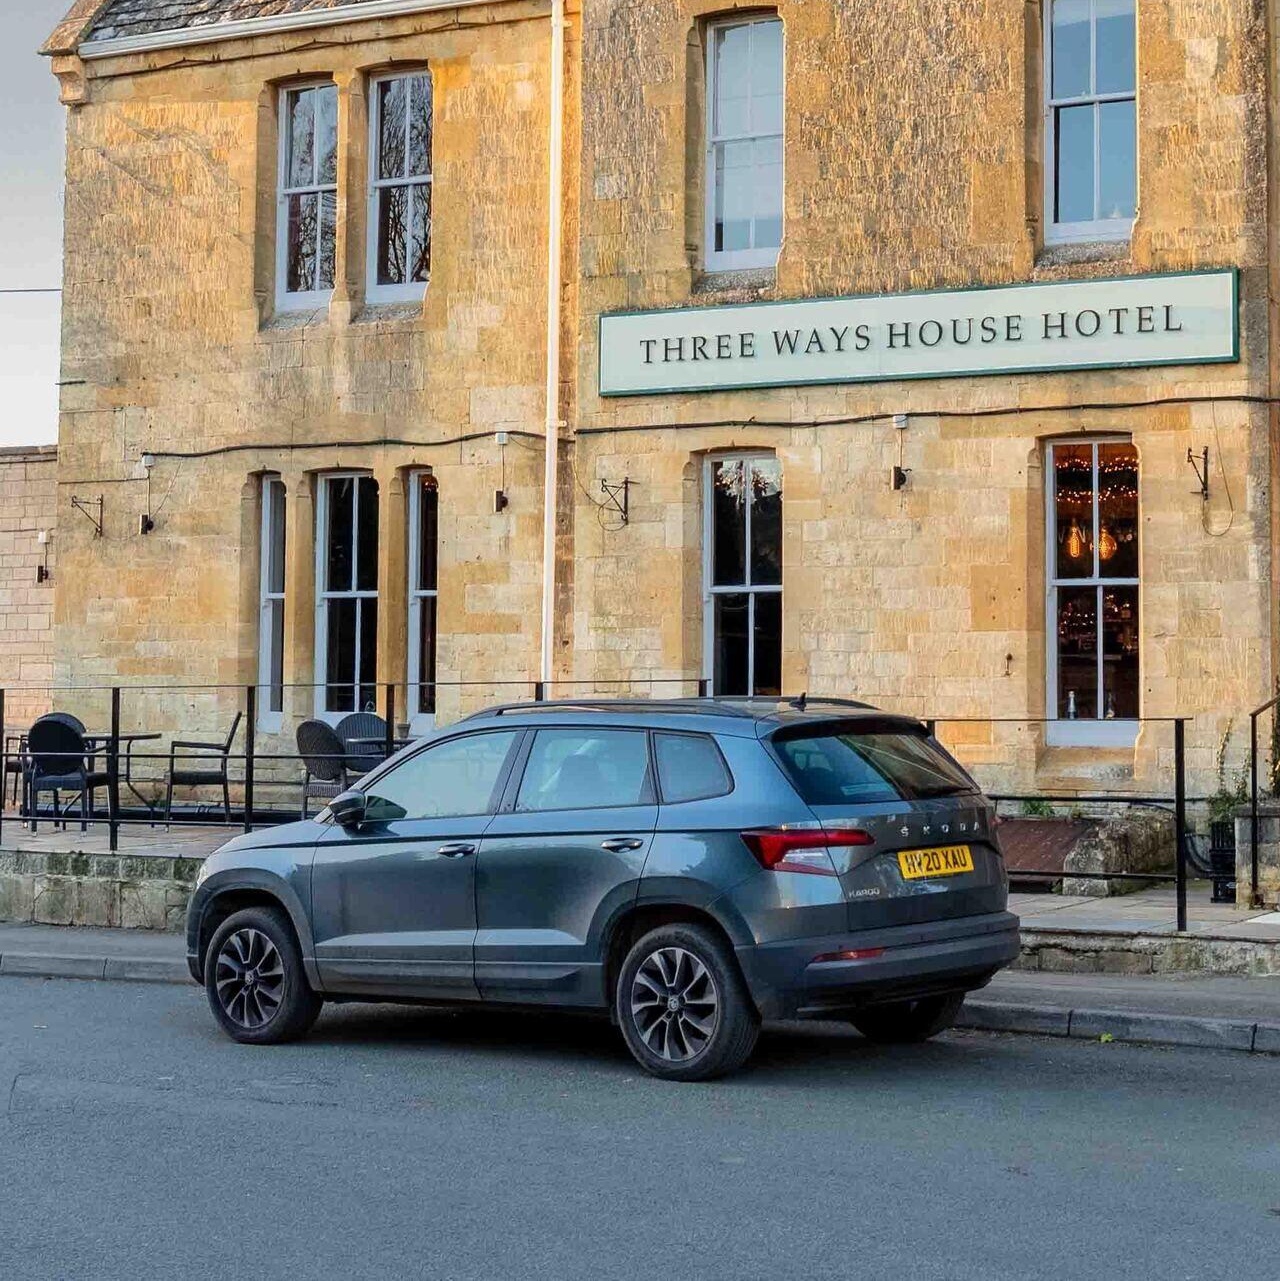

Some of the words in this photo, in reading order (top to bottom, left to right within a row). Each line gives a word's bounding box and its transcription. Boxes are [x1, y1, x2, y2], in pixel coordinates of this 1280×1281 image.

[640, 332, 756, 363] THREE
[772, 324, 871, 356] WAYS
[886, 315, 1023, 349] HOUSE
[1042, 304, 1183, 339] HOTEL
[941, 848, 967, 870] XAU
